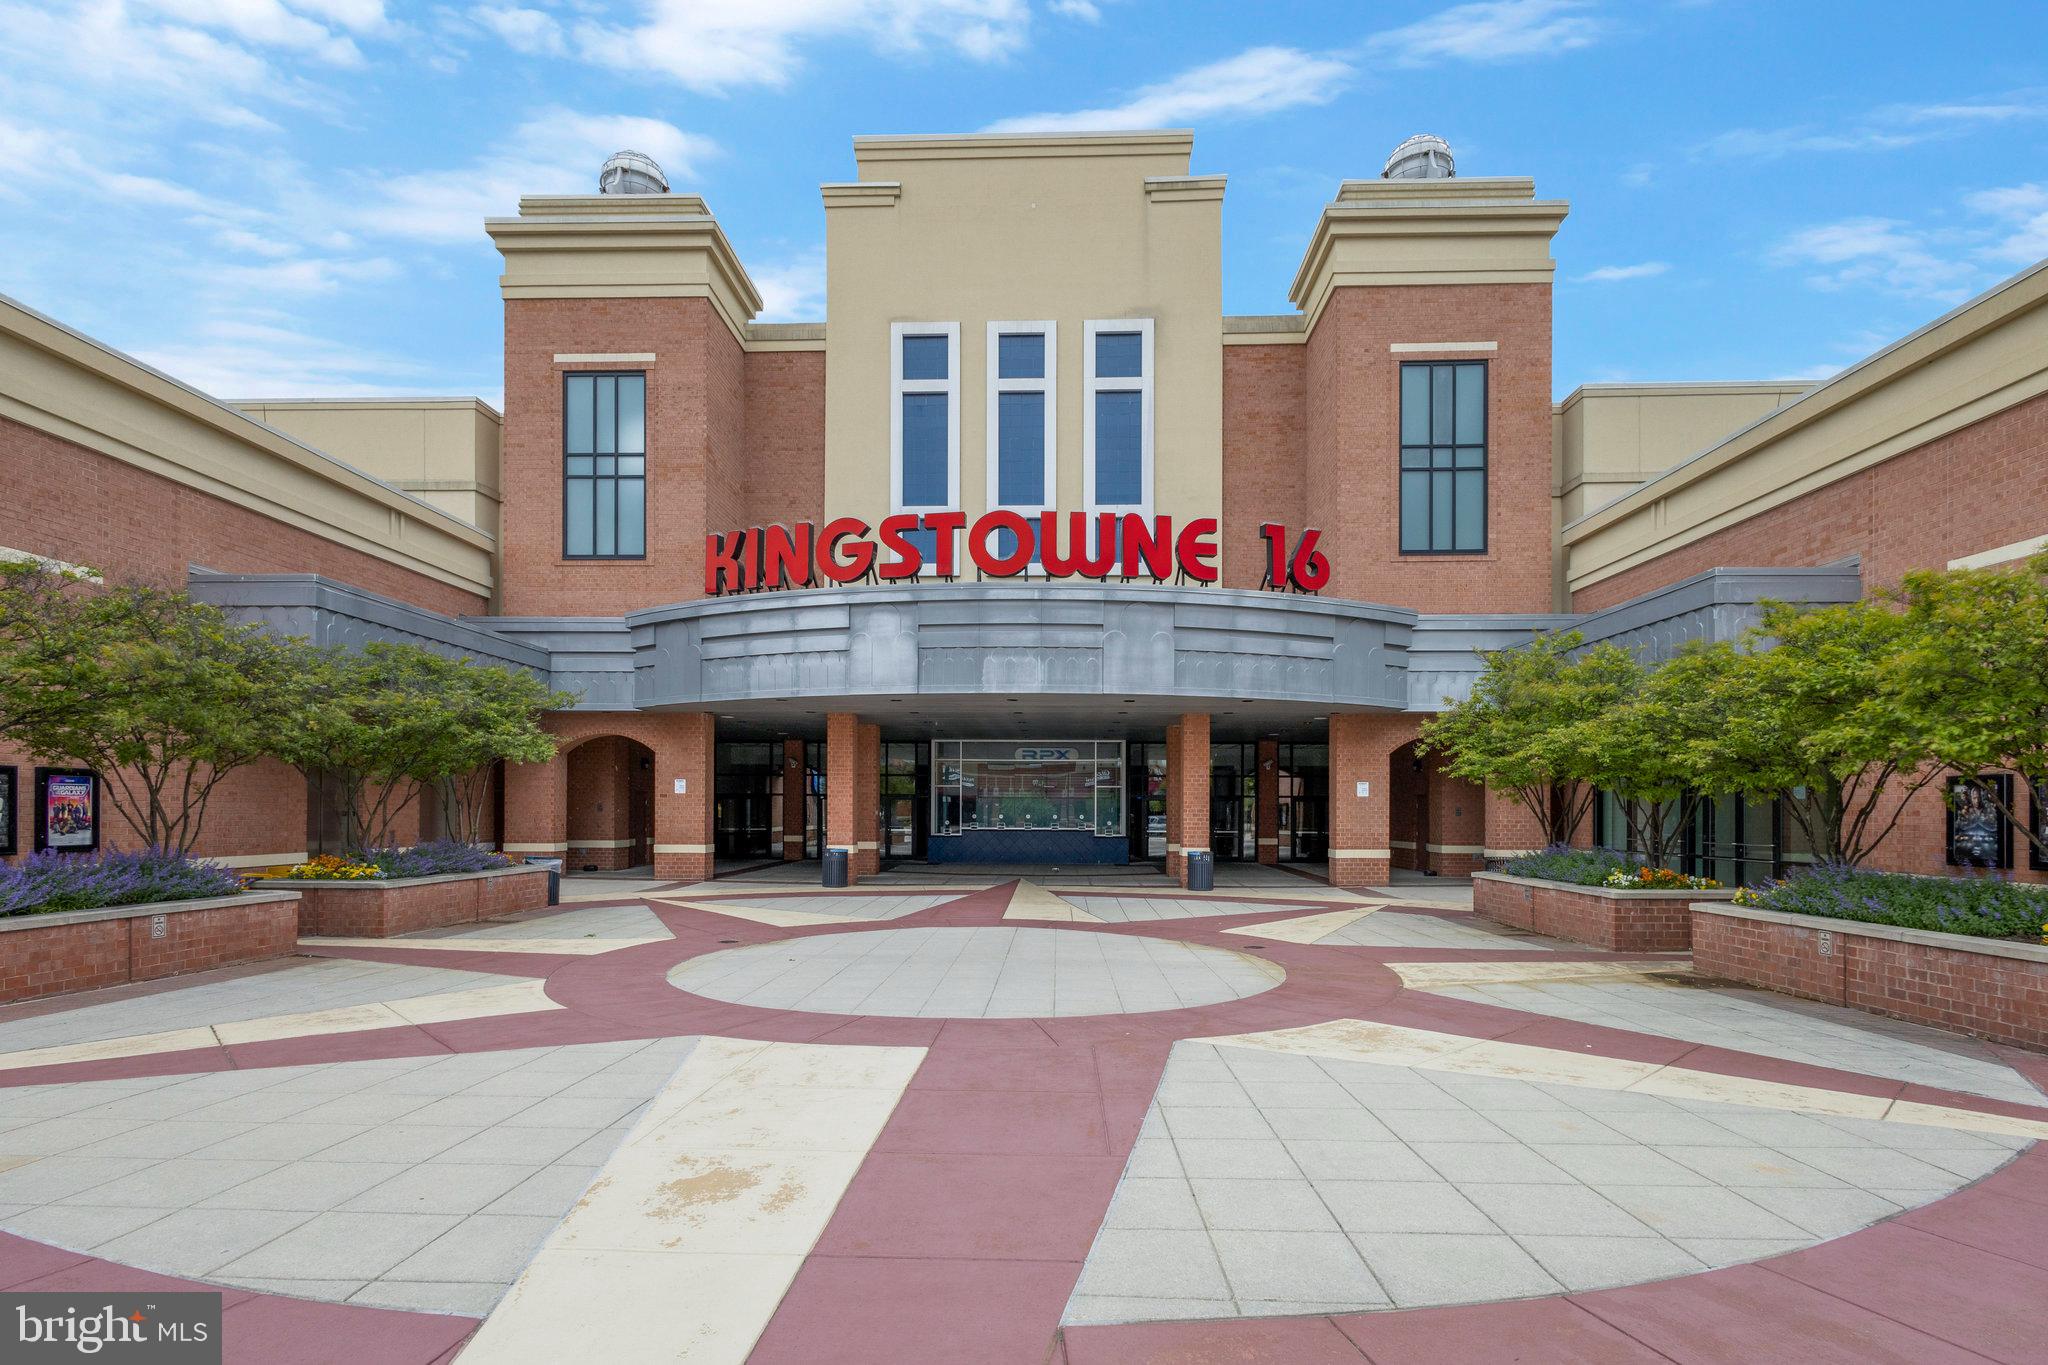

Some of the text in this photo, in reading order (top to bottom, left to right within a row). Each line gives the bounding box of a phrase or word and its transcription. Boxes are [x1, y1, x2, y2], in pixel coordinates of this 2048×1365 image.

[704, 510, 1332, 595] KINGSTOWNE 16
[1022, 749, 1069, 760] RPX
